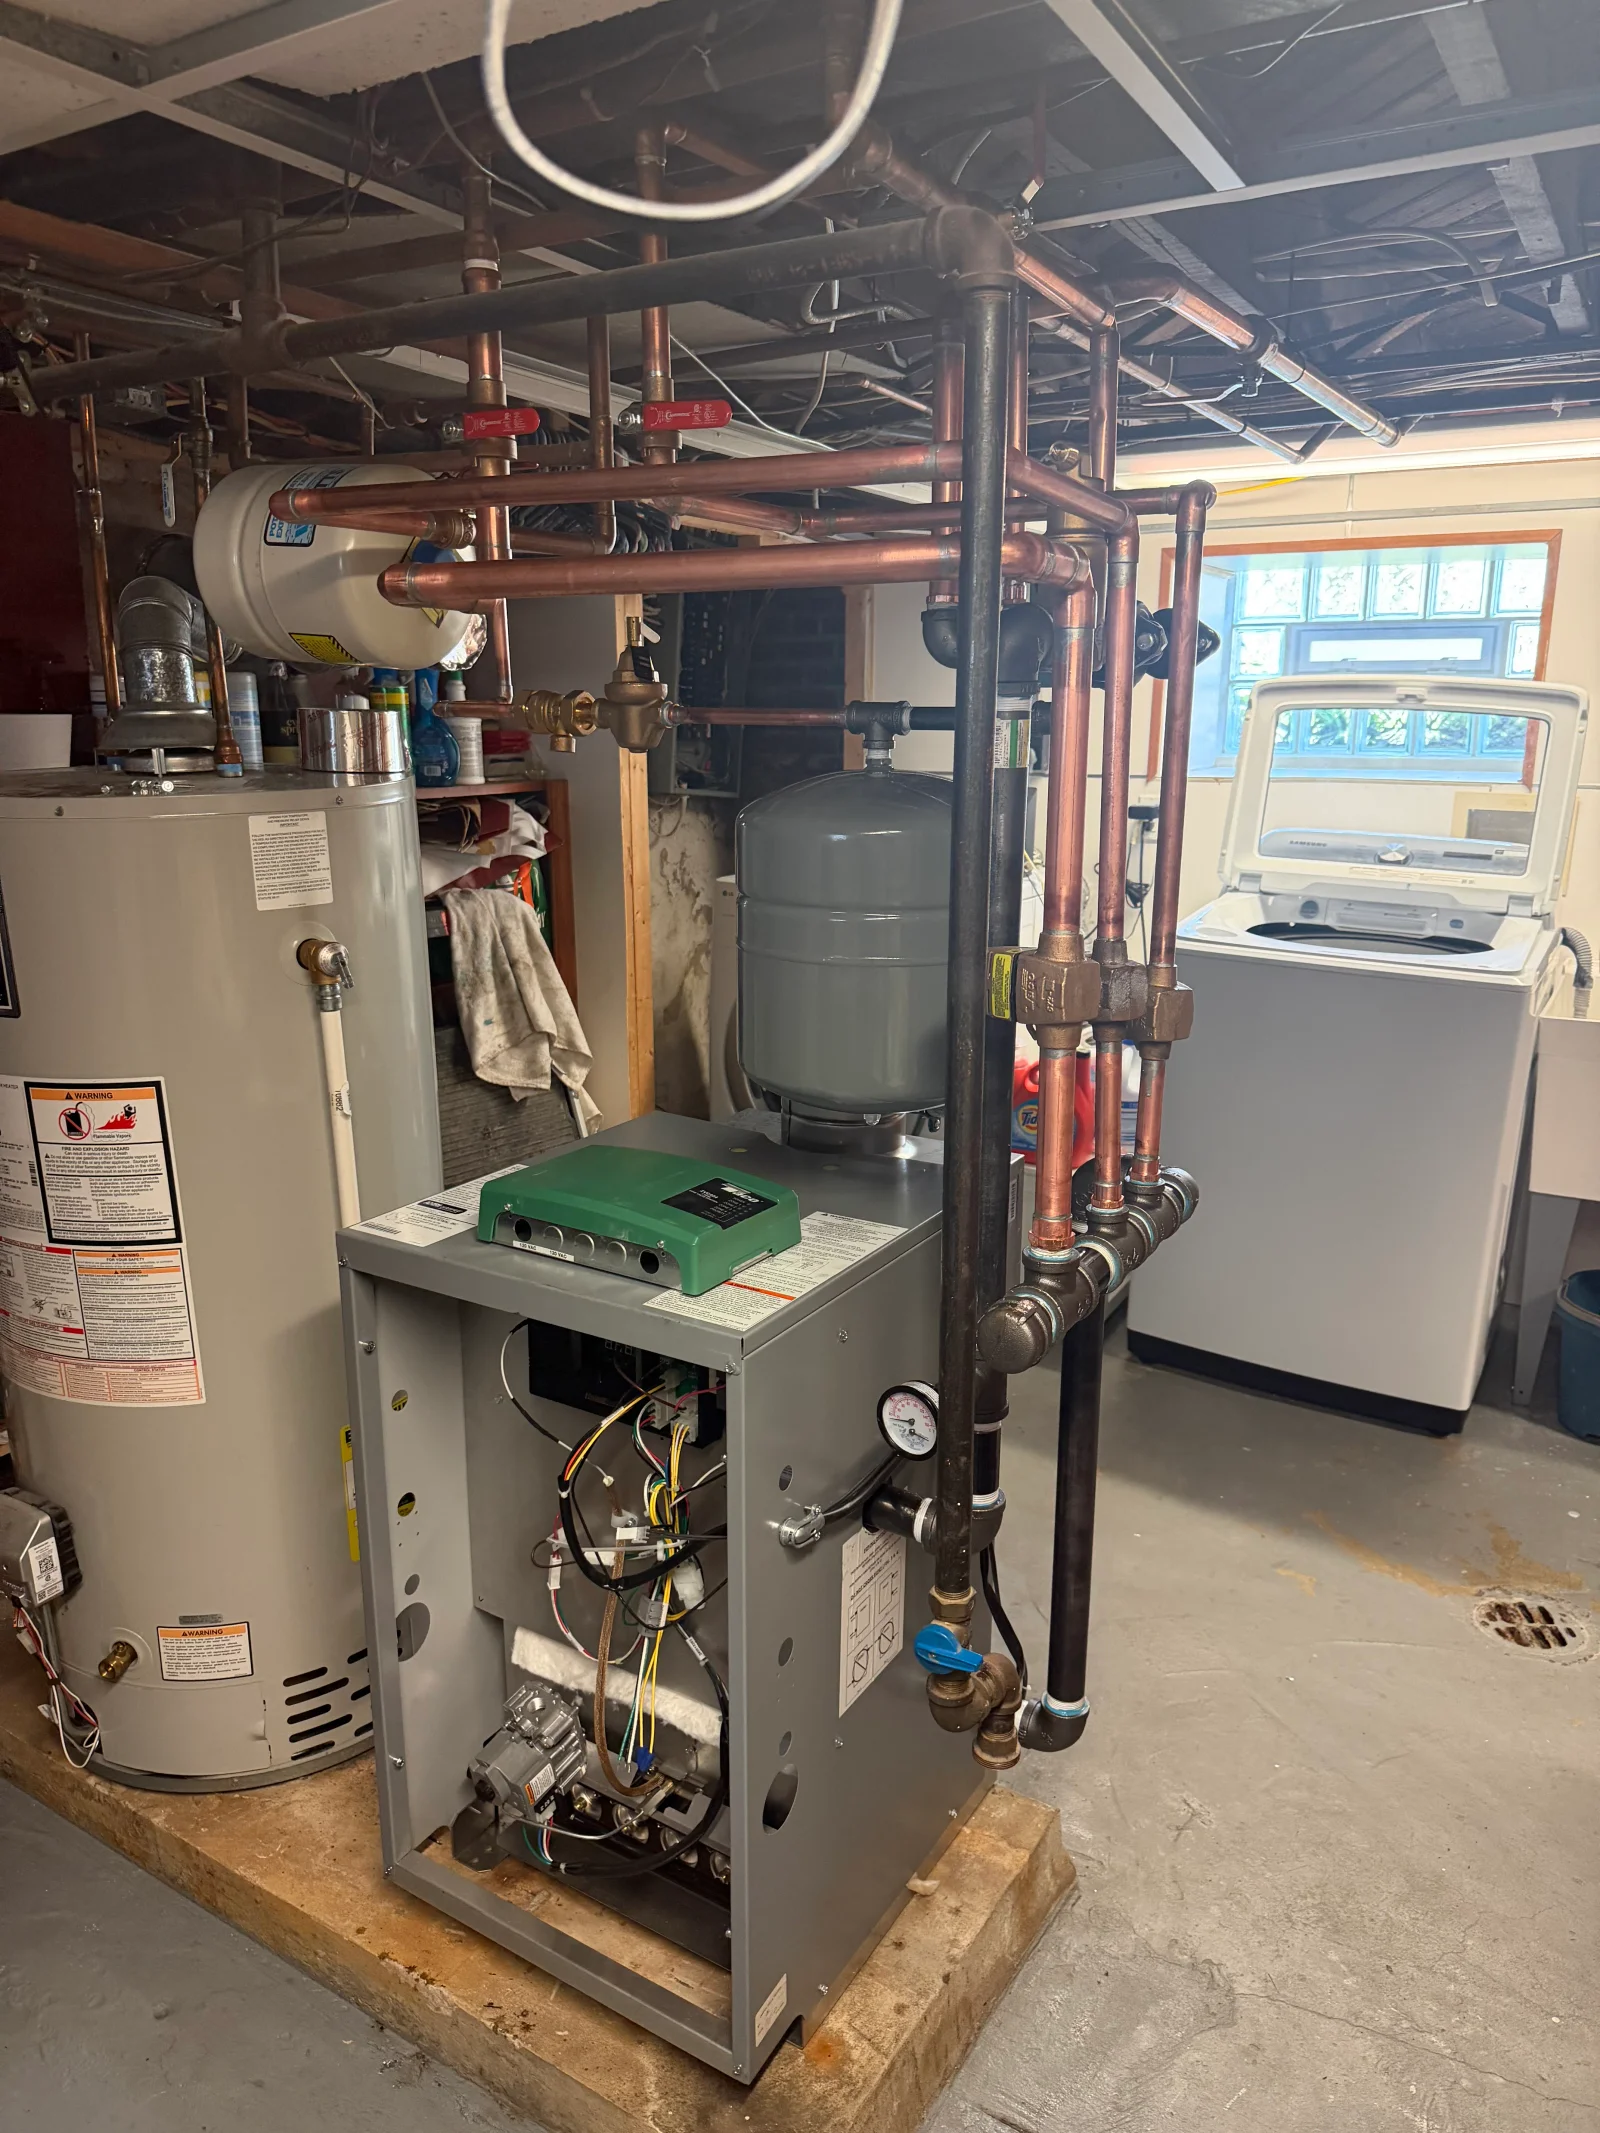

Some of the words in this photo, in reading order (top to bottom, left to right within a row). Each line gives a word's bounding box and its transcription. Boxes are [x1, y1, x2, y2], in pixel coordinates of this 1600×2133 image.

[74, 1092, 113, 1100] WARNING
[1022, 1110, 1038, 1126] Tid
[720, 1183, 760, 1203] Taco
[188, 1628, 224, 1636] WARNING
